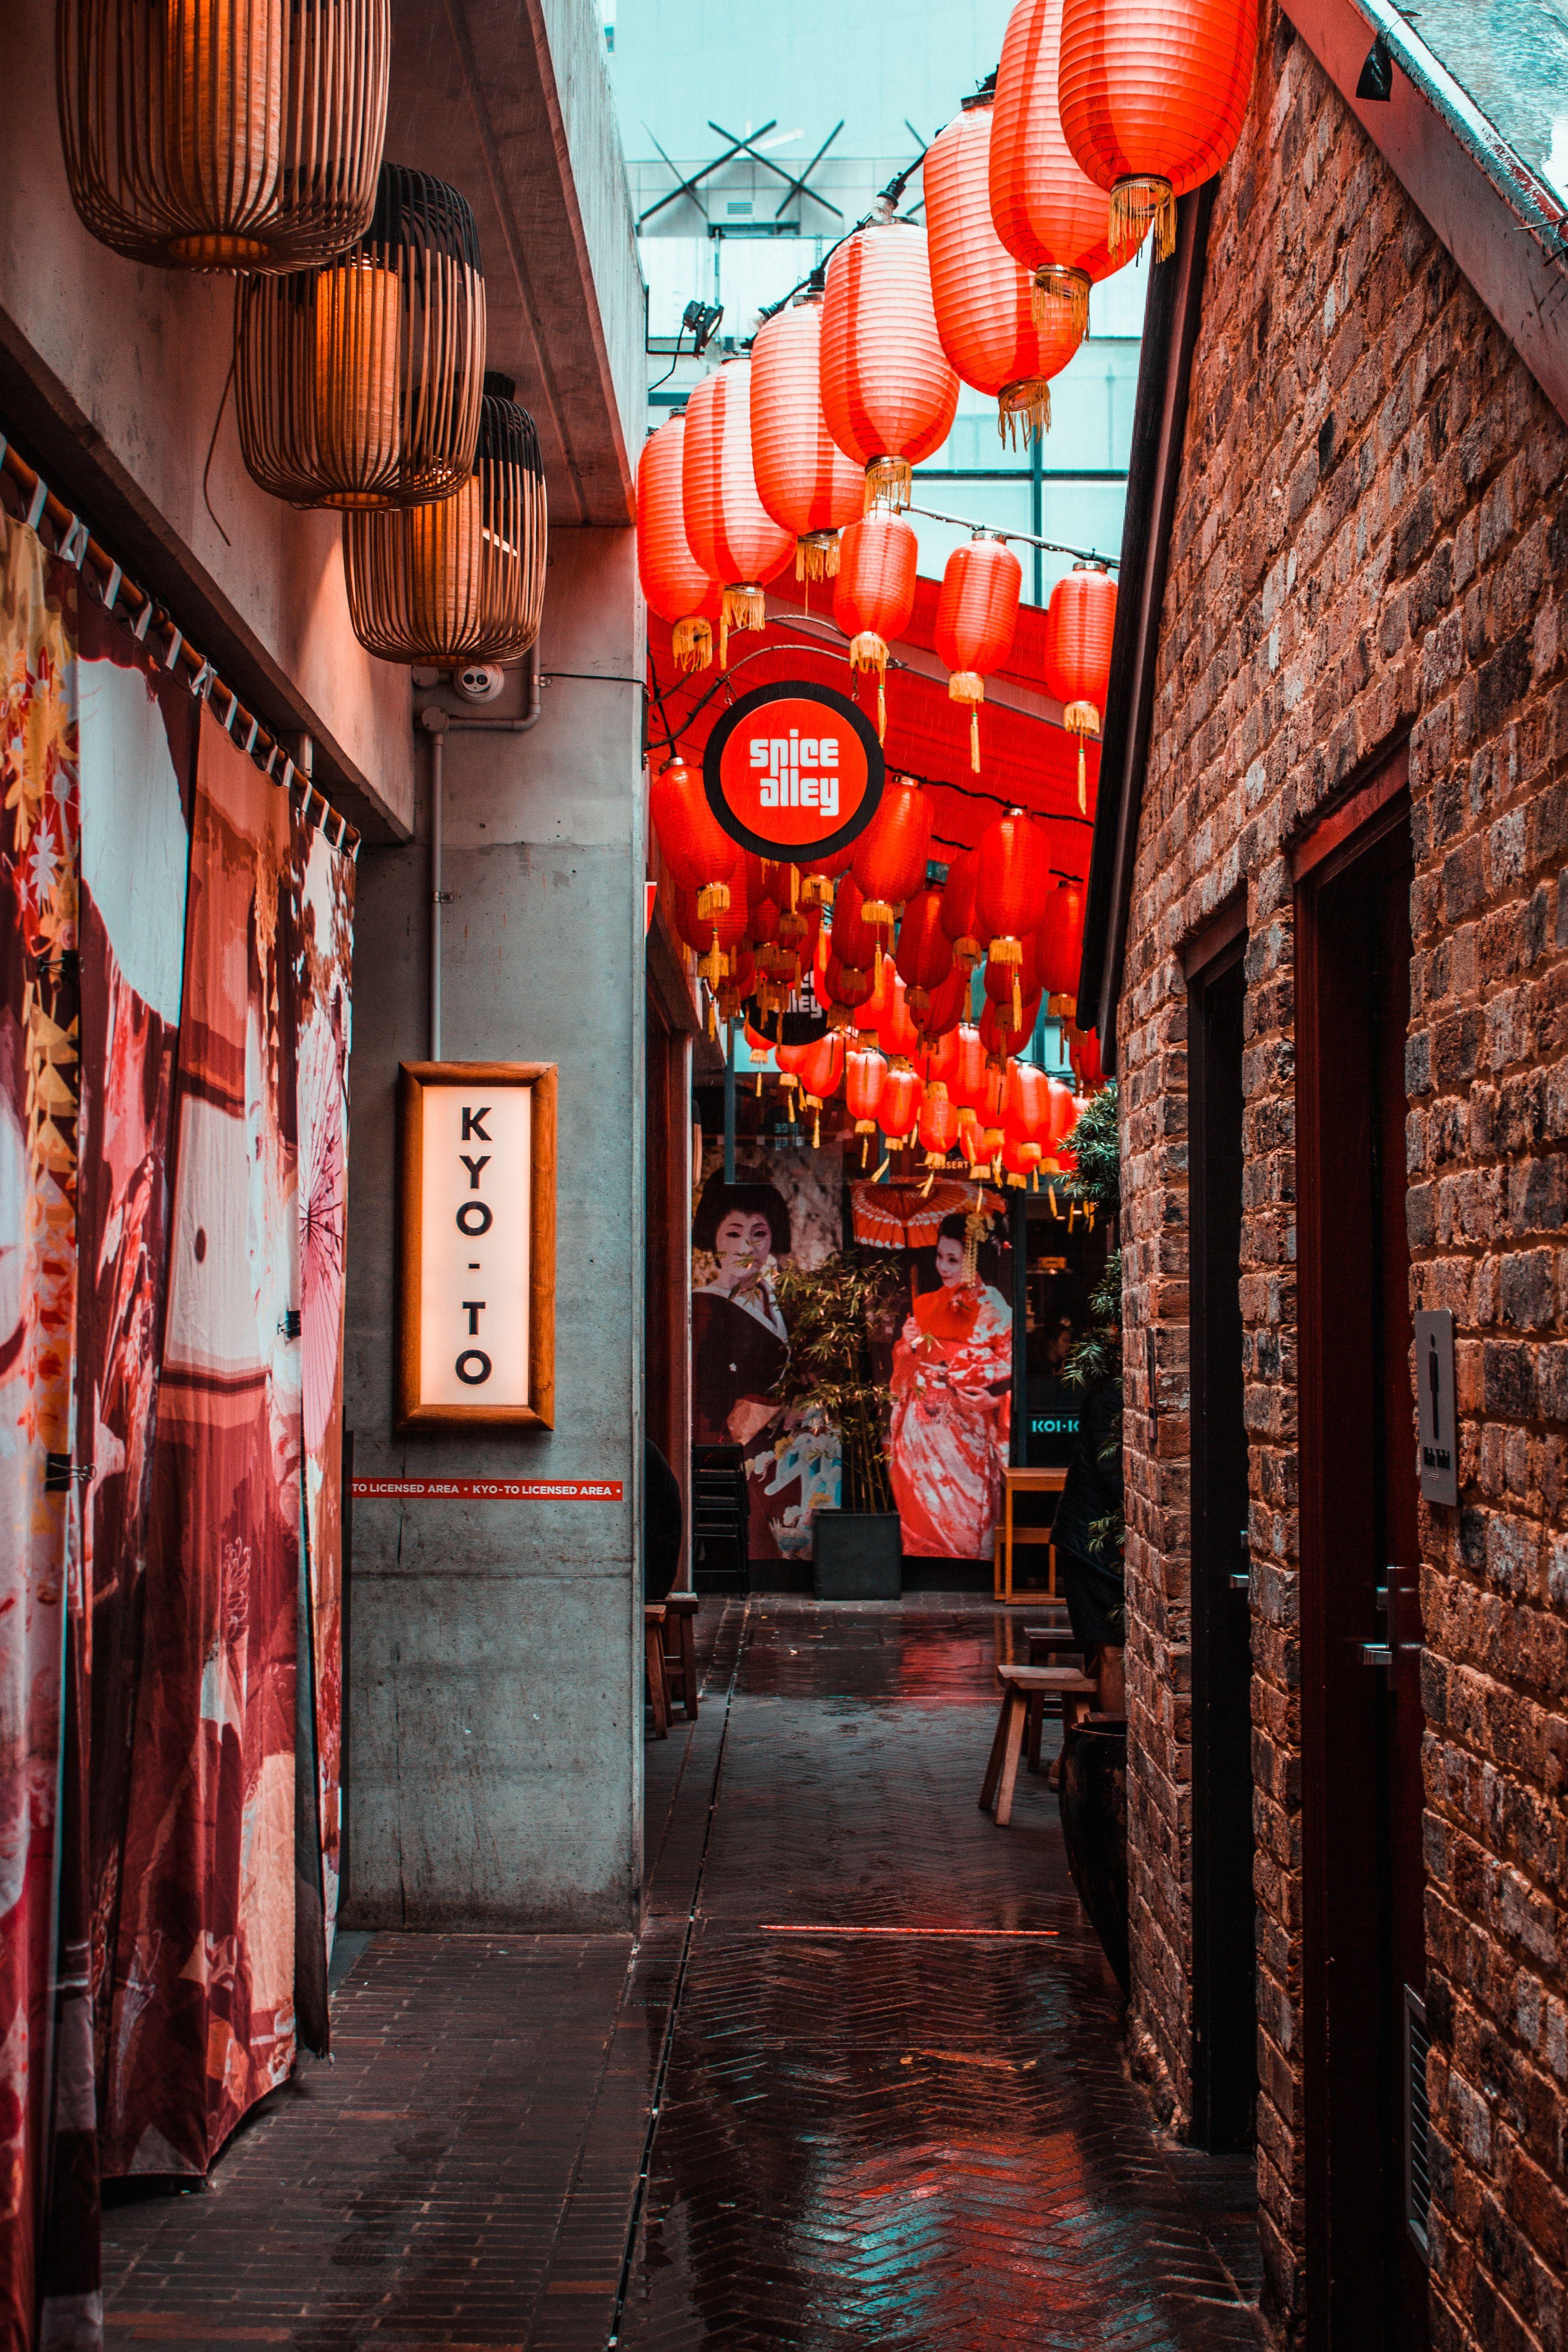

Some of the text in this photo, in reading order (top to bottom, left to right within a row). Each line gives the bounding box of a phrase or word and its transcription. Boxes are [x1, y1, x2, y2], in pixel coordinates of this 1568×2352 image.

[750, 729, 839, 777] spice
[760, 768, 839, 816] alley
[455, 1107, 493, 1385] KYO-TO
[352, 1483, 612, 1495] TO LICENSED AREA KYO-TO LICENSED AREA
